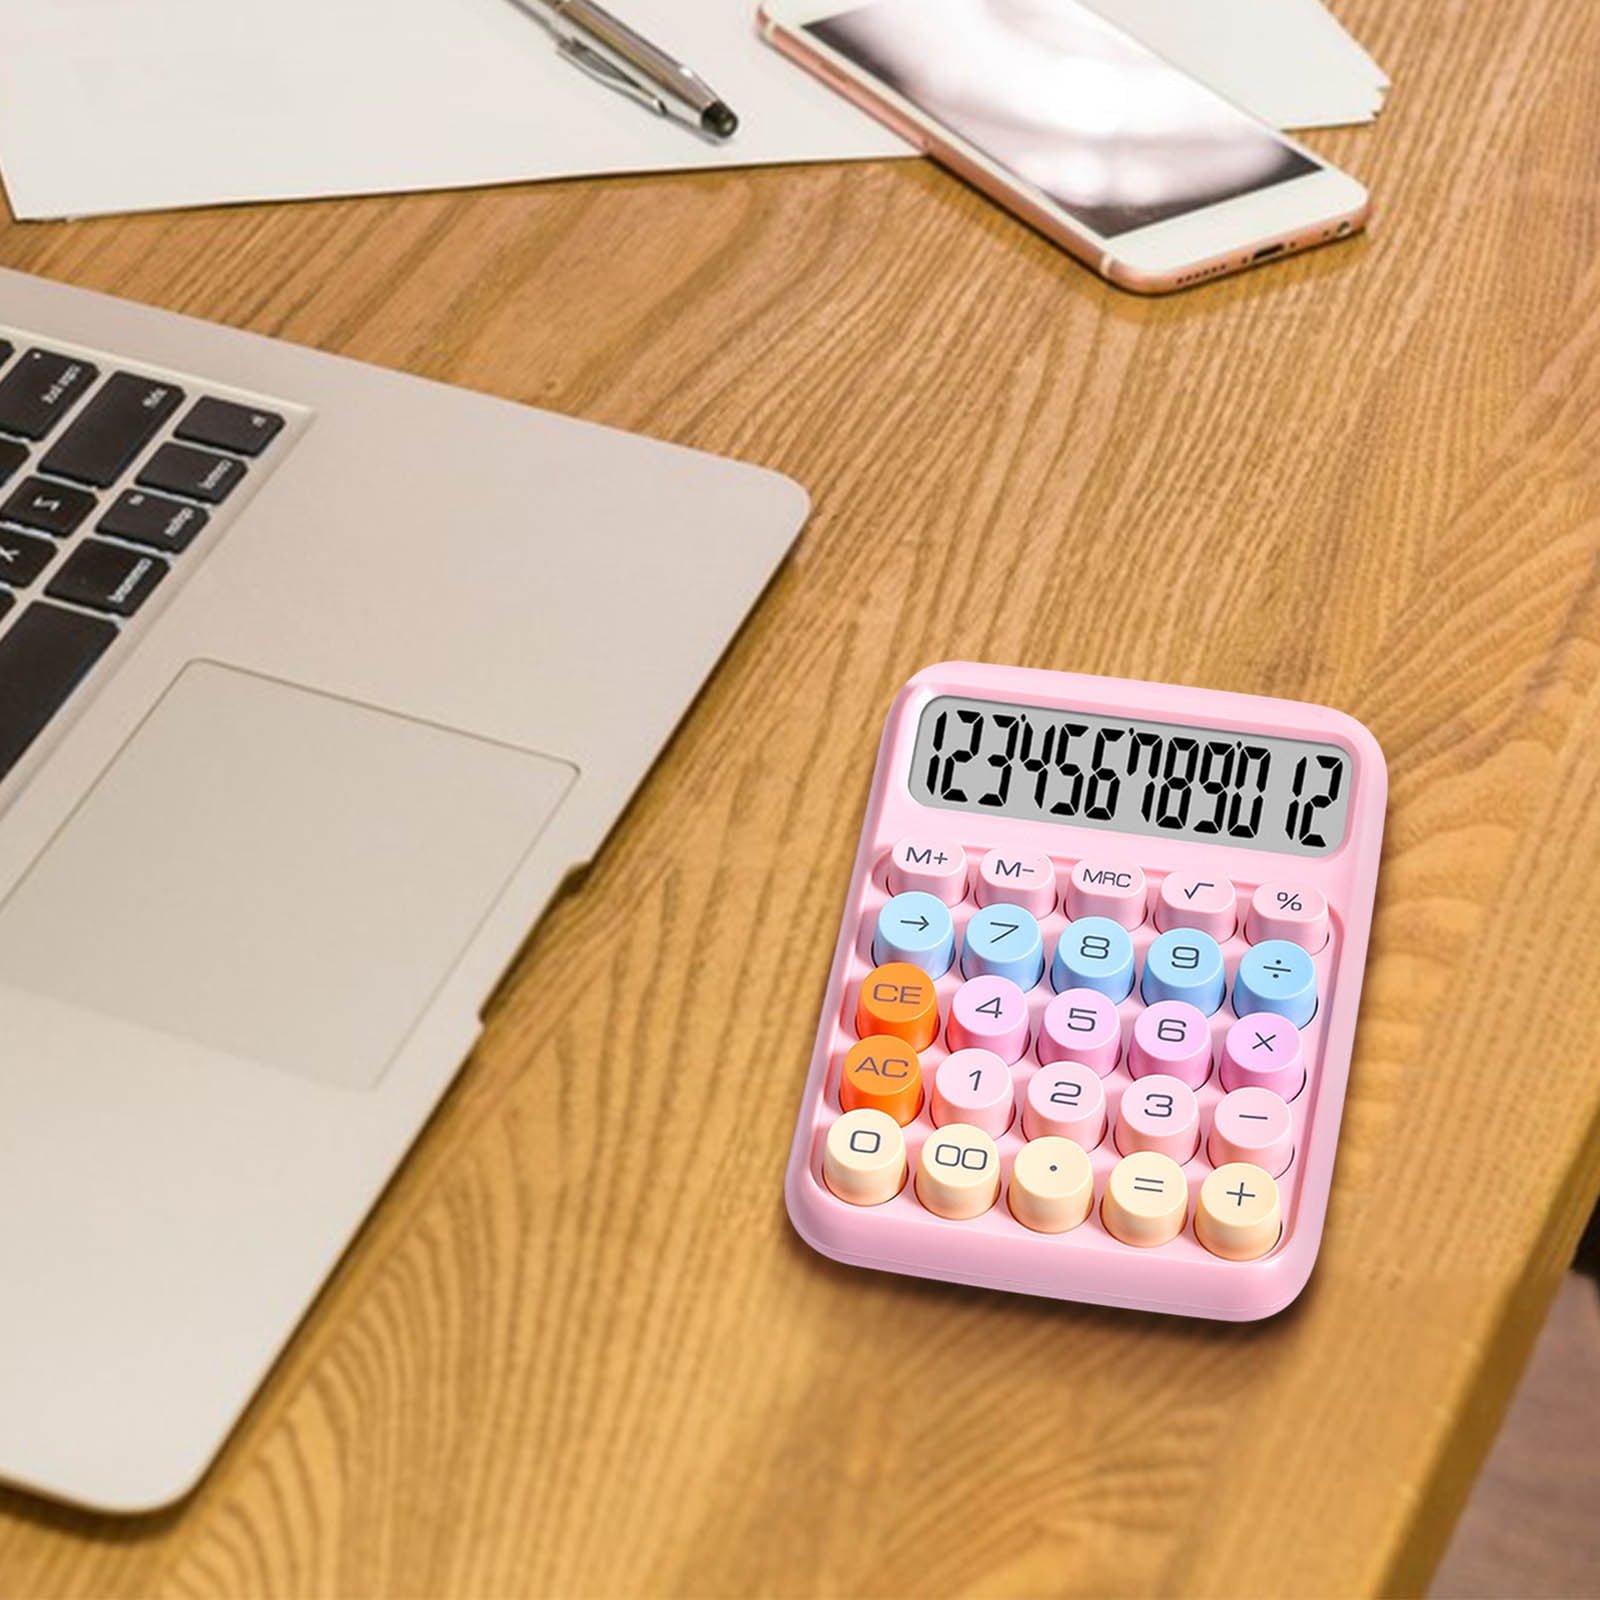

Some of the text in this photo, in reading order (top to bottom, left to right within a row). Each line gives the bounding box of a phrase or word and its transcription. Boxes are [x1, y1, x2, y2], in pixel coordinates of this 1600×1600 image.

[905, 846, 948, 866] M+
[995, 859, 1035, 878] M-
[1082, 868, 1132, 887] MRC
[1277, 892, 1302, 911] %
[990, 921, 1019, 944] 7
[1080, 935, 1110, 960] 8
[1171, 946, 1200, 969] 9
[873, 983, 922, 1005] CE
[975, 997, 1003, 1019] 4
[1067, 1007, 1097, 1032] 5
[1157, 1018, 1187, 1043] 6
[854, 1056, 909, 1078] AC
[969, 1070, 982, 1092] 1
[1050, 1081, 1082, 1106] 2
[1144, 1094, 1173, 1118] 3
[936, 1145, 988, 1171] 00
